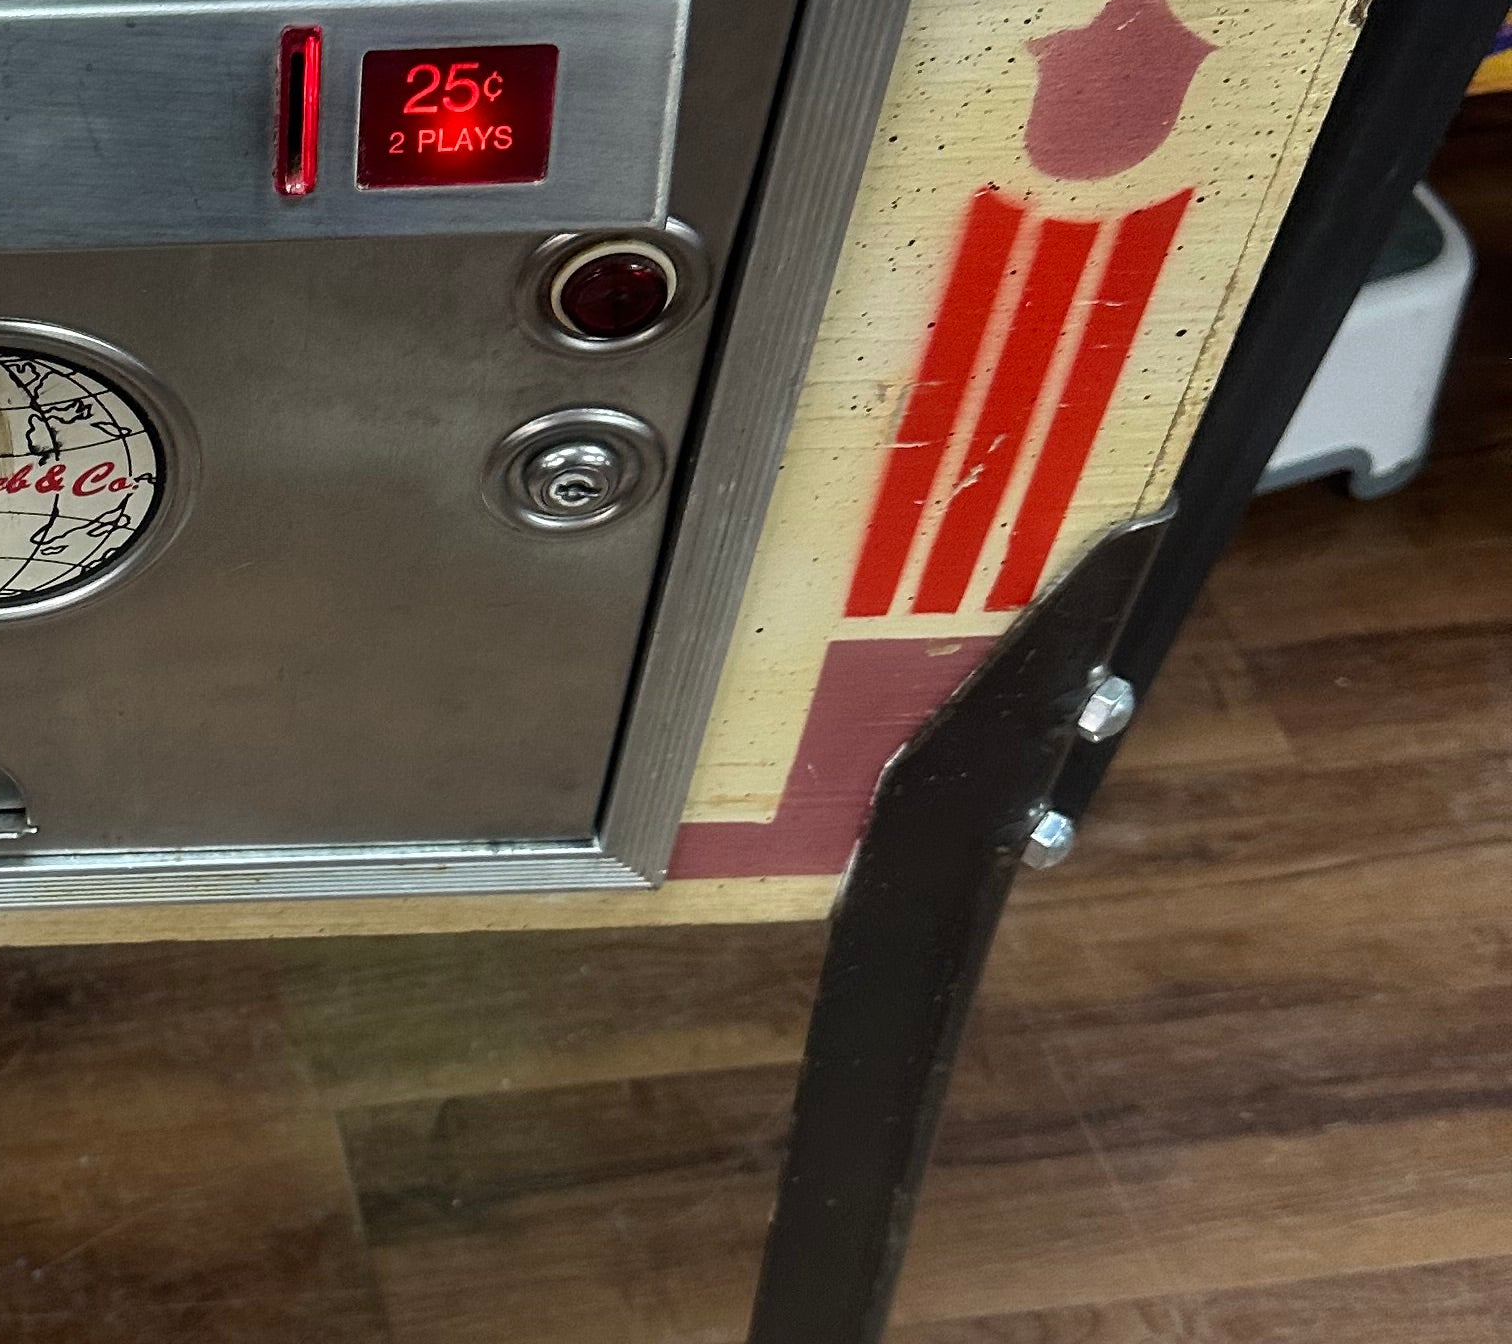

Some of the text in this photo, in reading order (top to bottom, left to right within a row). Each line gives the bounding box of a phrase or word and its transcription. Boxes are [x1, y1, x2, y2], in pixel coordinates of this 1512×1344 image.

[402, 61, 504, 115] 25¢
[388, 125, 513, 154] 2 PLAYS
